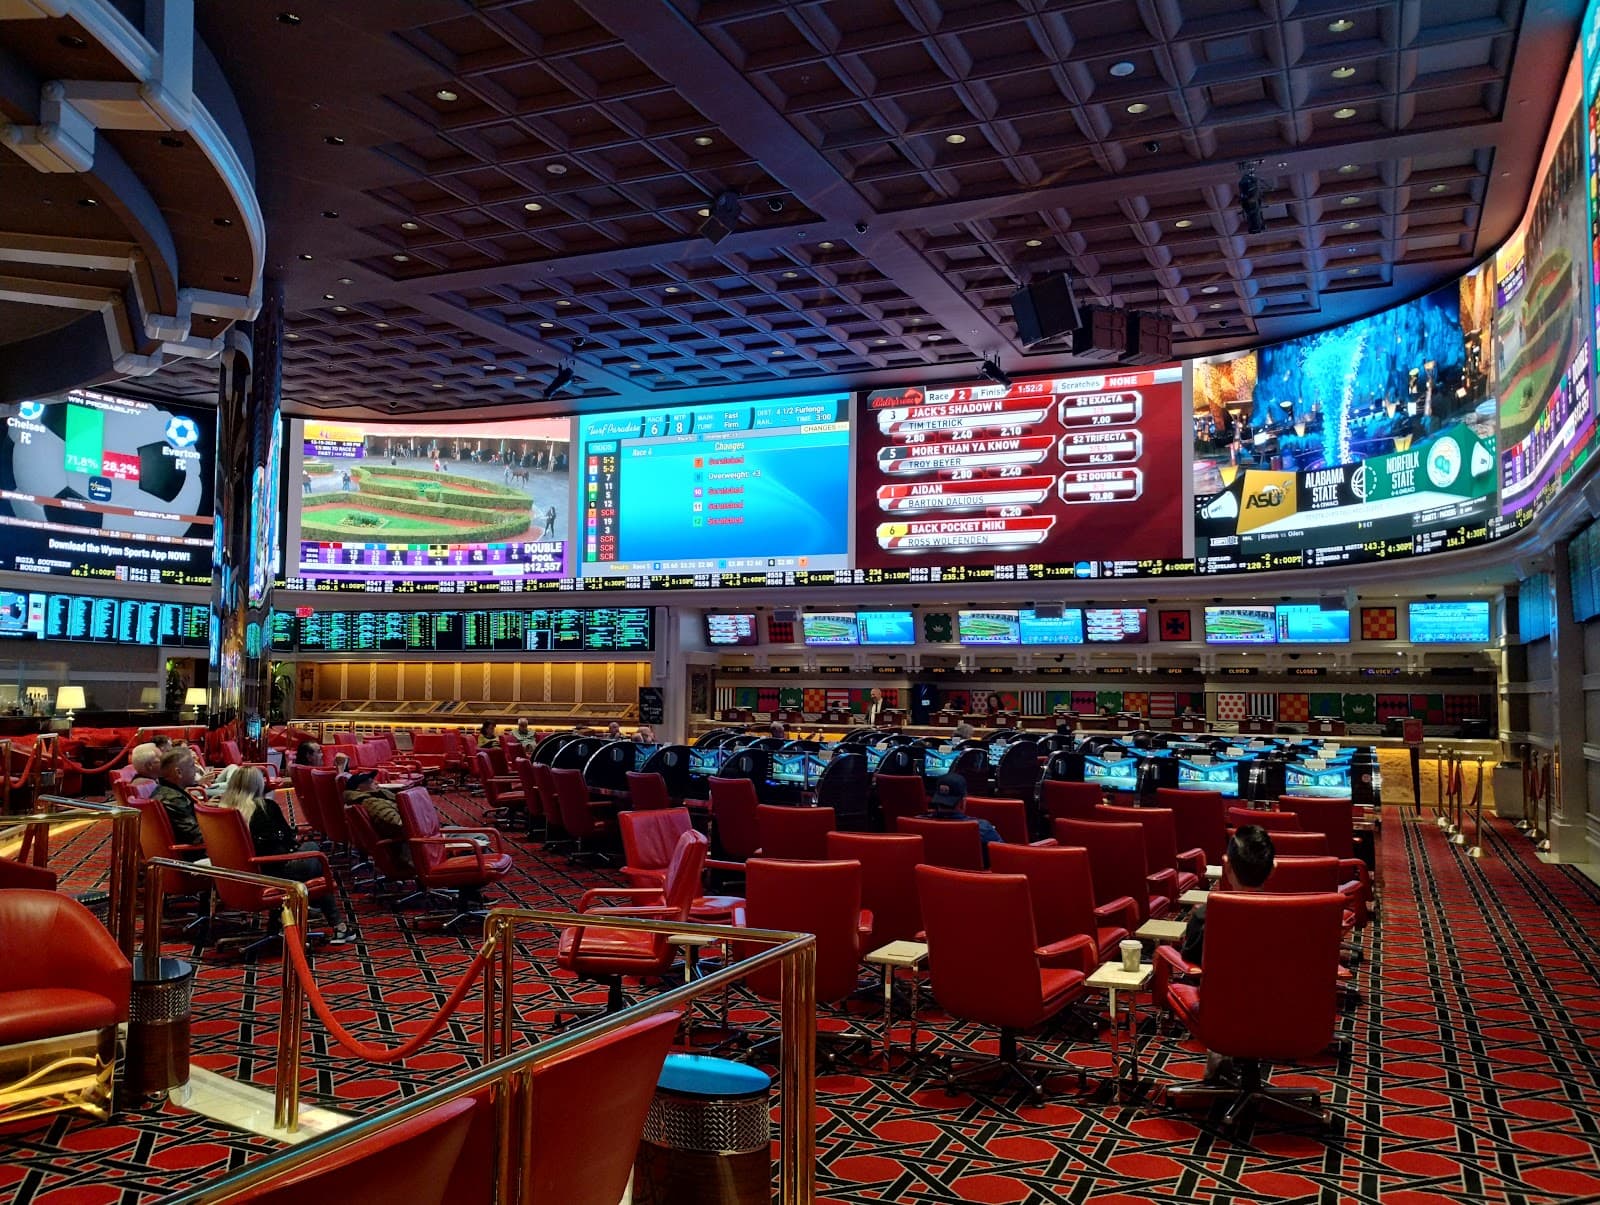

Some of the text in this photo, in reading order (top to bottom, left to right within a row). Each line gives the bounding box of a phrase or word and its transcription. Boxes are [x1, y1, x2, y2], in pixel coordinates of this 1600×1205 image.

[930, 393, 949, 401] Race
[959, 391, 965, 400] 2
[1018, 384, 1043, 393] 1:52:2
[1061, 382, 1101, 390] Scratches
[1110, 376, 1138, 386] NONE
[1089, 395, 1123, 404] EXACTA
[68, 396, 142, 416] WIN PROBABILITY
[796, 406, 825, 414] Furlongs
[912, 402, 1003, 418] JACK'S SHADOW N
[890, 411, 896, 420] 3
[7, 417, 46, 433] Chelsea
[587, 421, 640, 436] Turf Paradise
[651, 424, 658, 435] 6
[676, 422, 683, 433] 8
[803, 424, 836, 433] CHANGES
[909, 419, 963, 430] TIM TETRICK
[952, 430, 973, 439] 2.40
[1001, 427, 1022, 436] 2.10
[1073, 433, 1127, 444] $2 TRIFECTA
[20, 433, 32, 445] FC
[714, 442, 745, 452] Changes
[912, 440, 1020, 456] MORE THAN YA KNOW
[162, 446, 201, 460] Everton
[889, 448, 897, 458] 5
[66, 454, 99, 469] 71.8%
[175, 458, 187, 471] FC
[909, 458, 961, 469] TROY BEYER
[1386, 451, 1420, 474] NORFOLK
[103, 460, 139, 475] 28.2%
[1001, 467, 1022, 476] 2.40
[606, 474, 611, 482] 7
[1089, 471, 1123, 481] DOUBLE
[1304, 468, 1345, 489] ALABAMA
[1392, 470, 1415, 490] STATE
[604, 482, 613, 490] 11
[911, 485, 943, 495] AIDAN
[1312, 484, 1338, 503] STATE
[1, 490, 181, 521] SPREAD TOTAL MONEYLINE
[604, 500, 613, 508] 12
[908, 496, 984, 508] BARTON DALIOUS
[1246, 492, 1281, 510] ASU
[600, 508, 615, 517] SCR
[604, 526, 611, 534] 3
[889, 526, 896, 535] 6
[912, 520, 1006, 534] BACK POCKET MIKI
[908, 535, 989, 546] ROSS WOLFENDEN
[49, 538, 191, 562] Download the Wynn Sports App NOW!
[524, 542, 563, 554] DOUBLE
[600, 544, 615, 552] SCR
[532, 554, 554, 562] POOL
[1260, 553, 1271, 561] -2
[1273, 556, 1302, 565] 4:00PT
[20, 564, 51, 573] HOUSTON
[524, 562, 561, 573] $12,557
[1046, 567, 1075, 575] 7:10PT
[1164, 562, 1195, 571] 4:00PT
